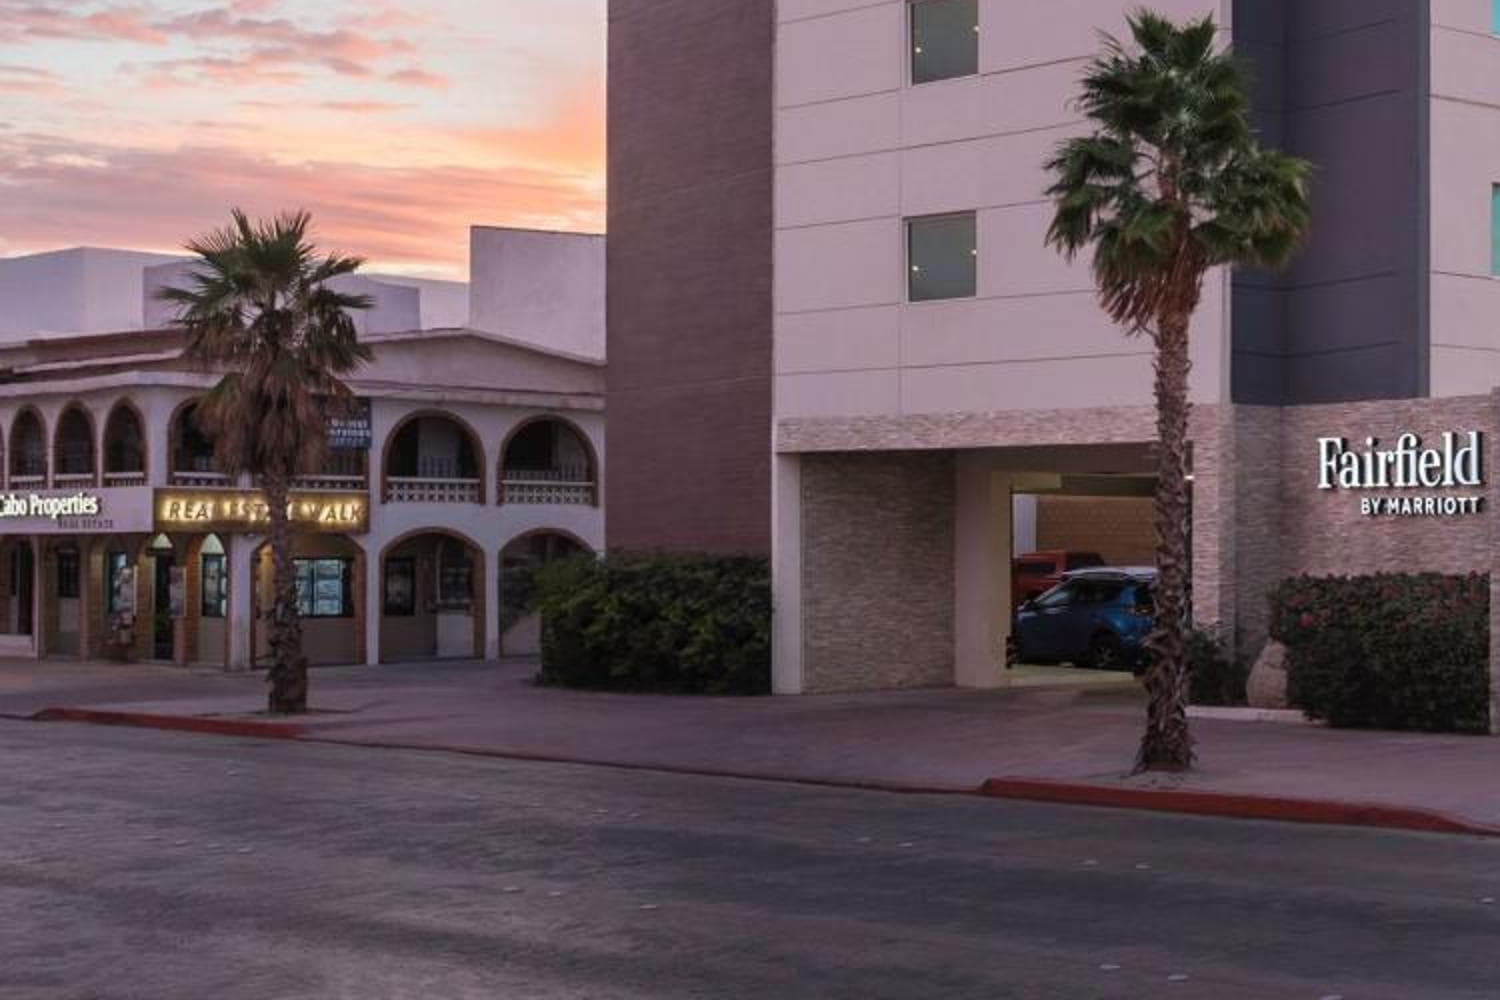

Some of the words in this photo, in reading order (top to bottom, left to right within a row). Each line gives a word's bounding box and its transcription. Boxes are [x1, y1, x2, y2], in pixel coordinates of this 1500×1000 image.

[1317, 431, 1482, 489] Fairfield
[29, 491, 98, 519] Properties
[307, 502, 364, 521] WALK
[1361, 497, 1380, 515] BY
[1387, 496, 1480, 515] MARRIOTT
